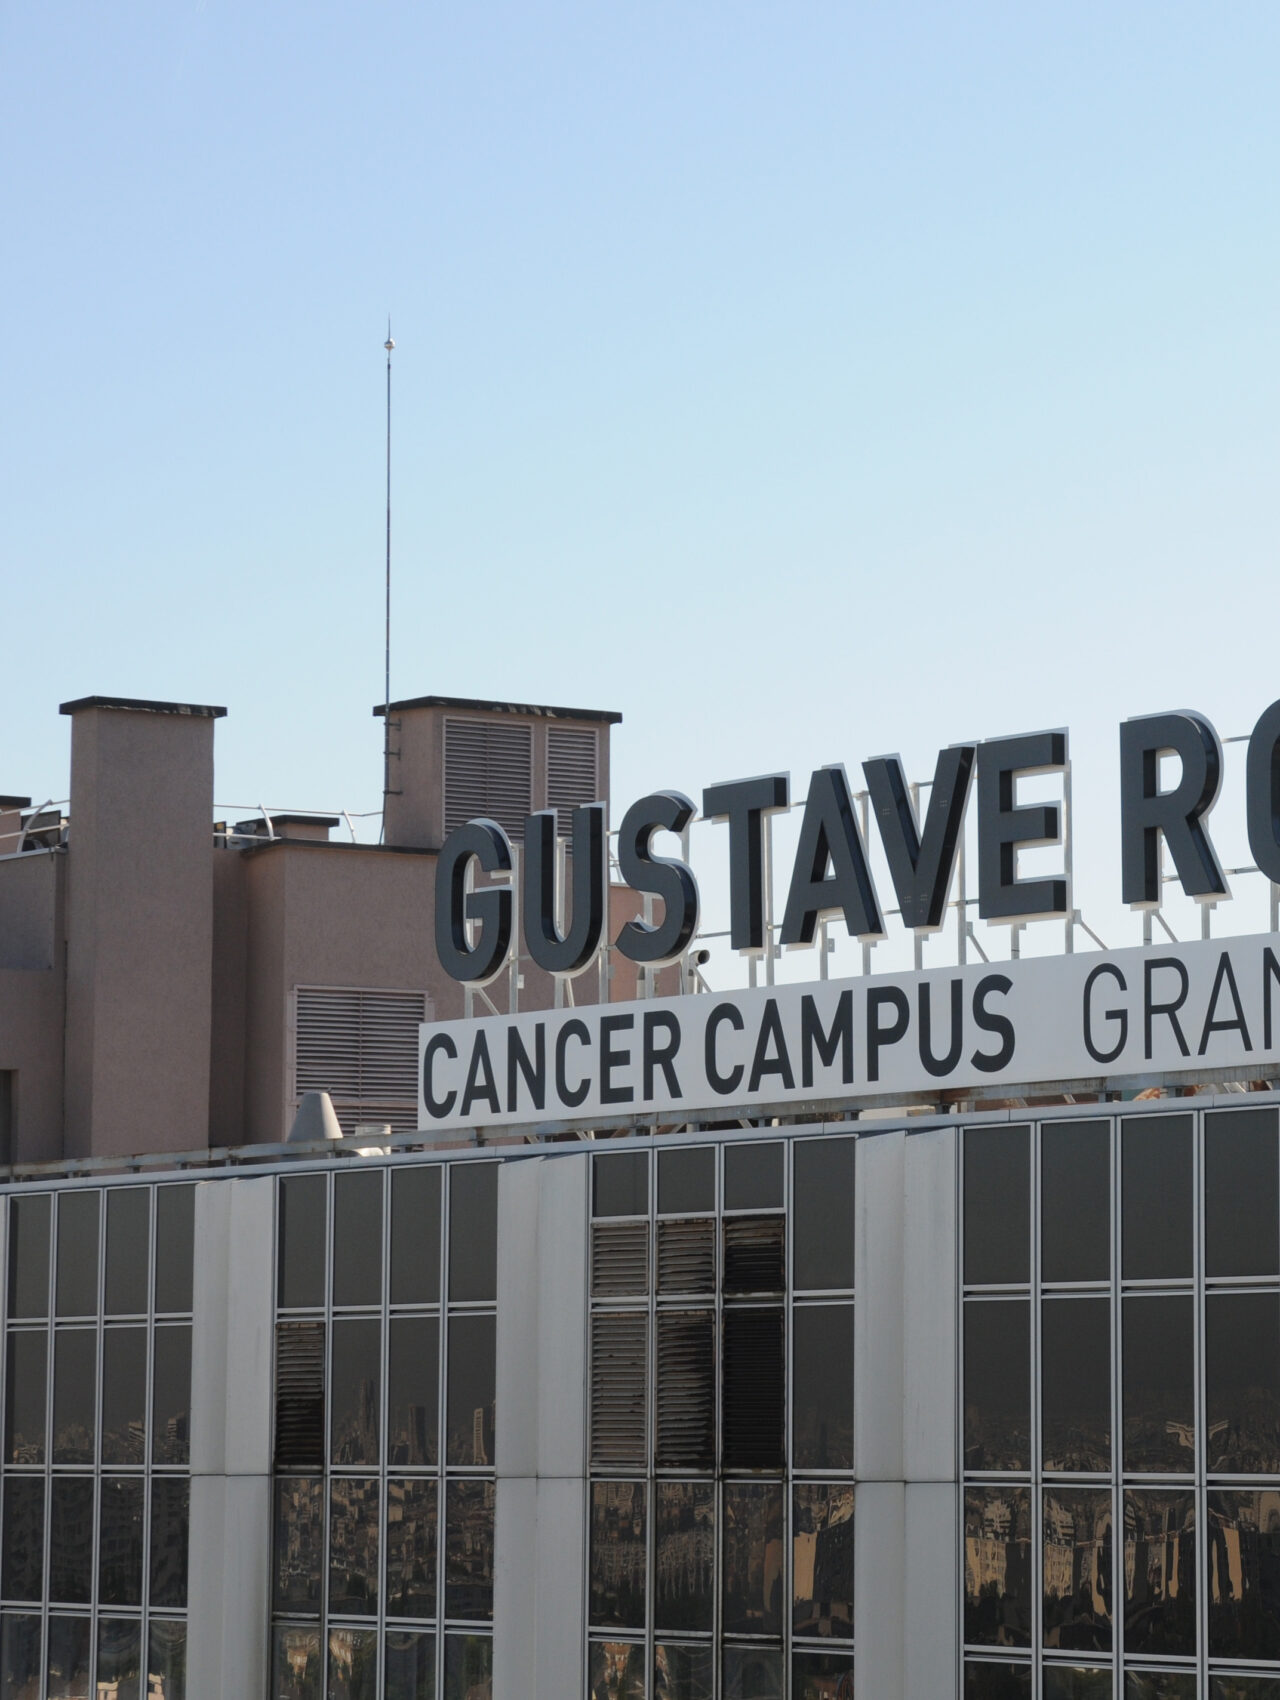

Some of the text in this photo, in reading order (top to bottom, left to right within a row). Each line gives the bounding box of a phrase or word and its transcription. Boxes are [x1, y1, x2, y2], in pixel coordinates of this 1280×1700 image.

[434, 728, 1069, 986] GUSTAVE
[423, 1009, 682, 1119] CANCER
[704, 974, 1017, 1096] CAMPUS
